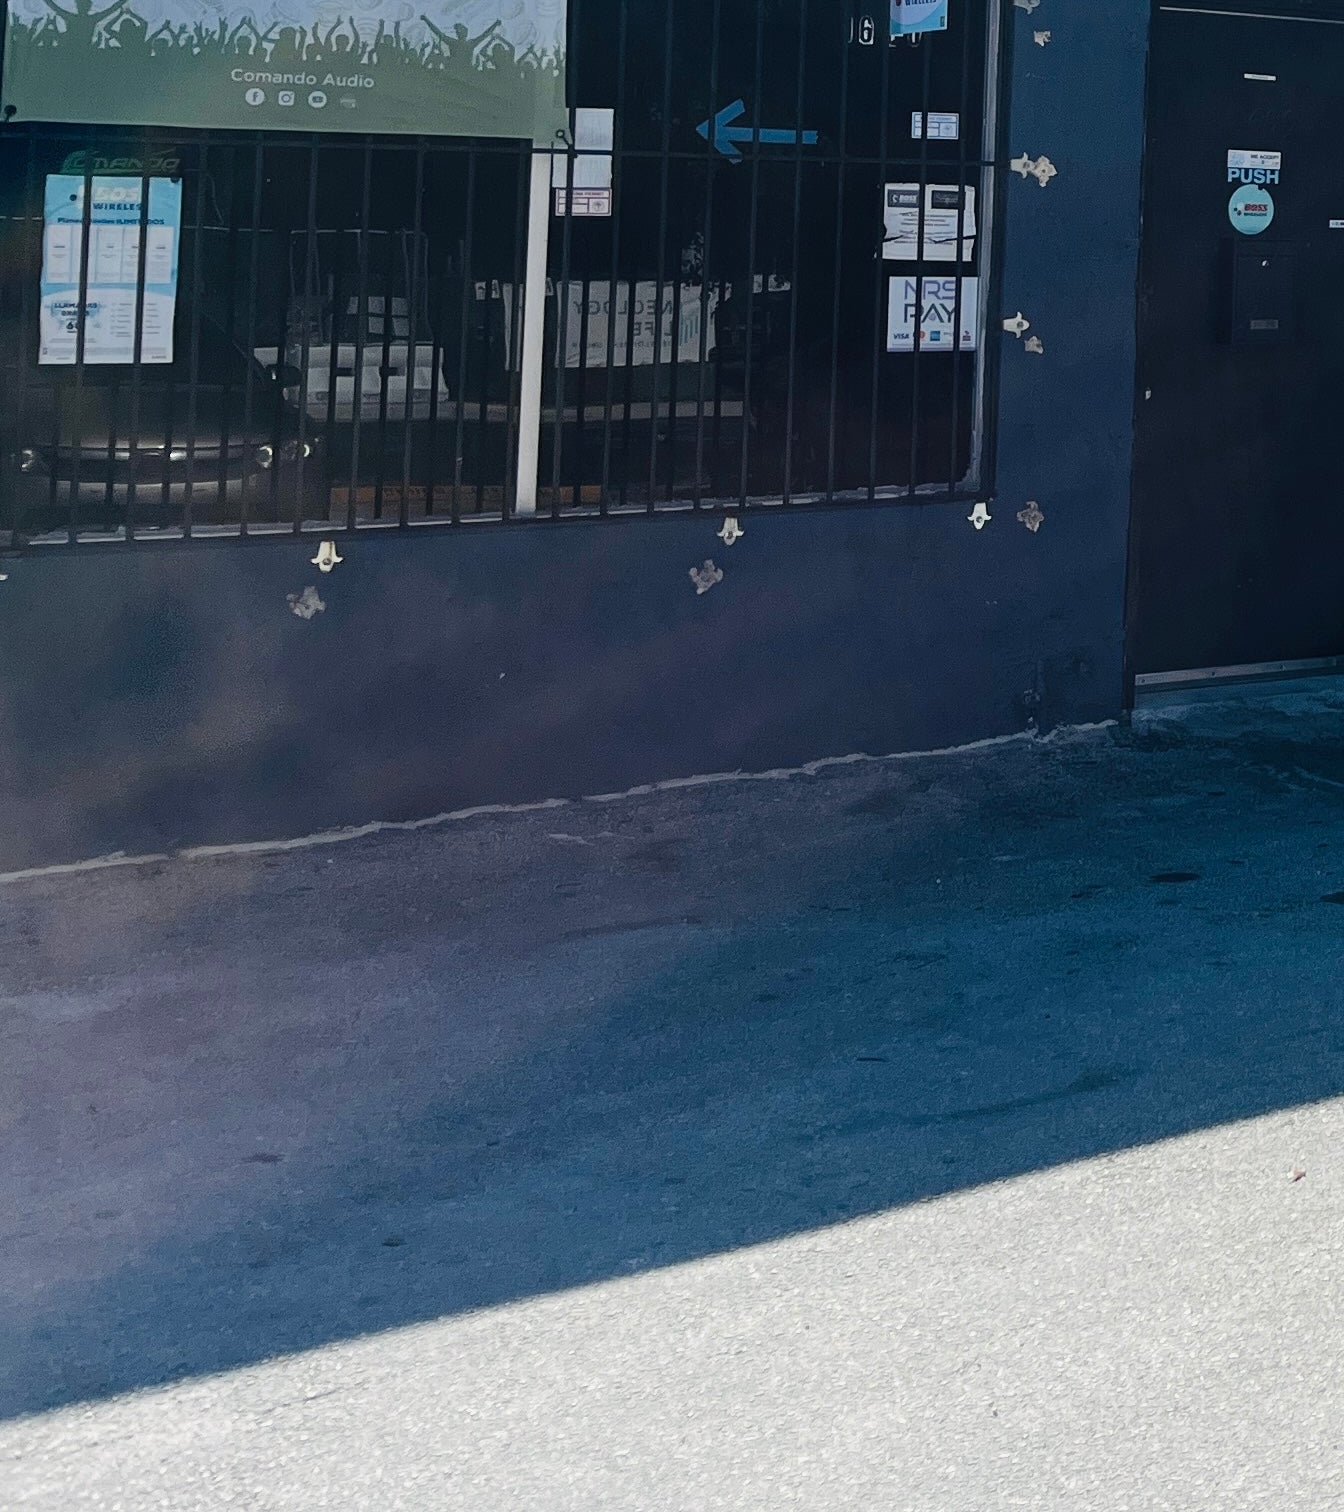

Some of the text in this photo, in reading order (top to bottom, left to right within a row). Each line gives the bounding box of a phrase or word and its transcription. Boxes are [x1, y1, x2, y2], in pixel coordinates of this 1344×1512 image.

[230, 67, 375, 90] Comando Audio
[1227, 167, 1280, 185] PUSH
[903, 303, 956, 324] PAY
